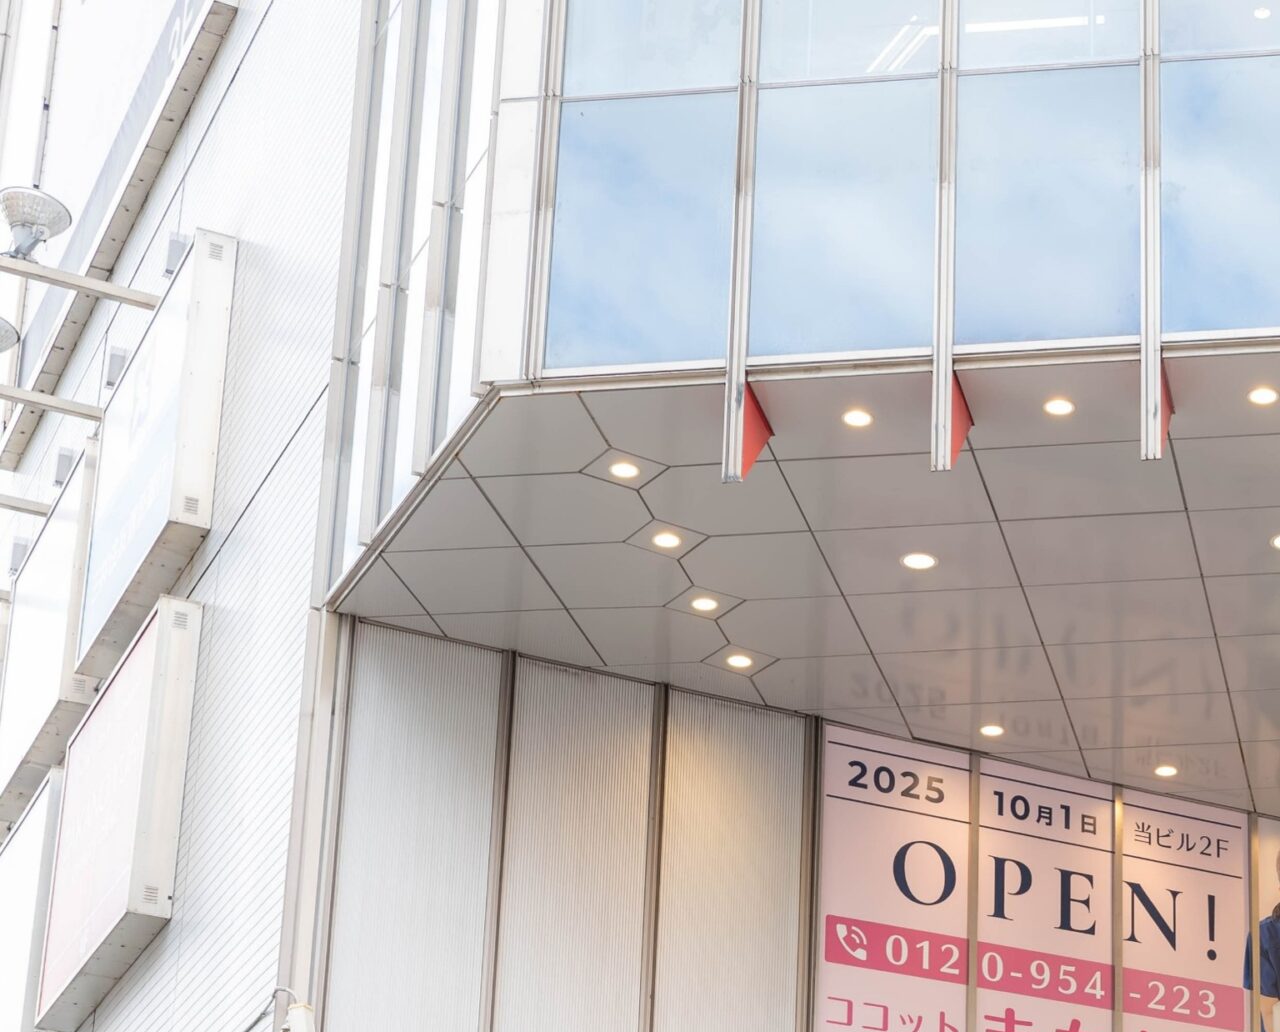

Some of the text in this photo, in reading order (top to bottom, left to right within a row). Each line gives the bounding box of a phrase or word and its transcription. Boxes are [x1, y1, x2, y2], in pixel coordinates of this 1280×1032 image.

[847, 759, 946, 804] 2025
[993, 790, 1098, 837] 10月1日
[1133, 821, 1231, 860] 当ビル2F
[893, 840, 1219, 962] OPEN!
[884, 933, 1219, 1019] 0120-954-223
